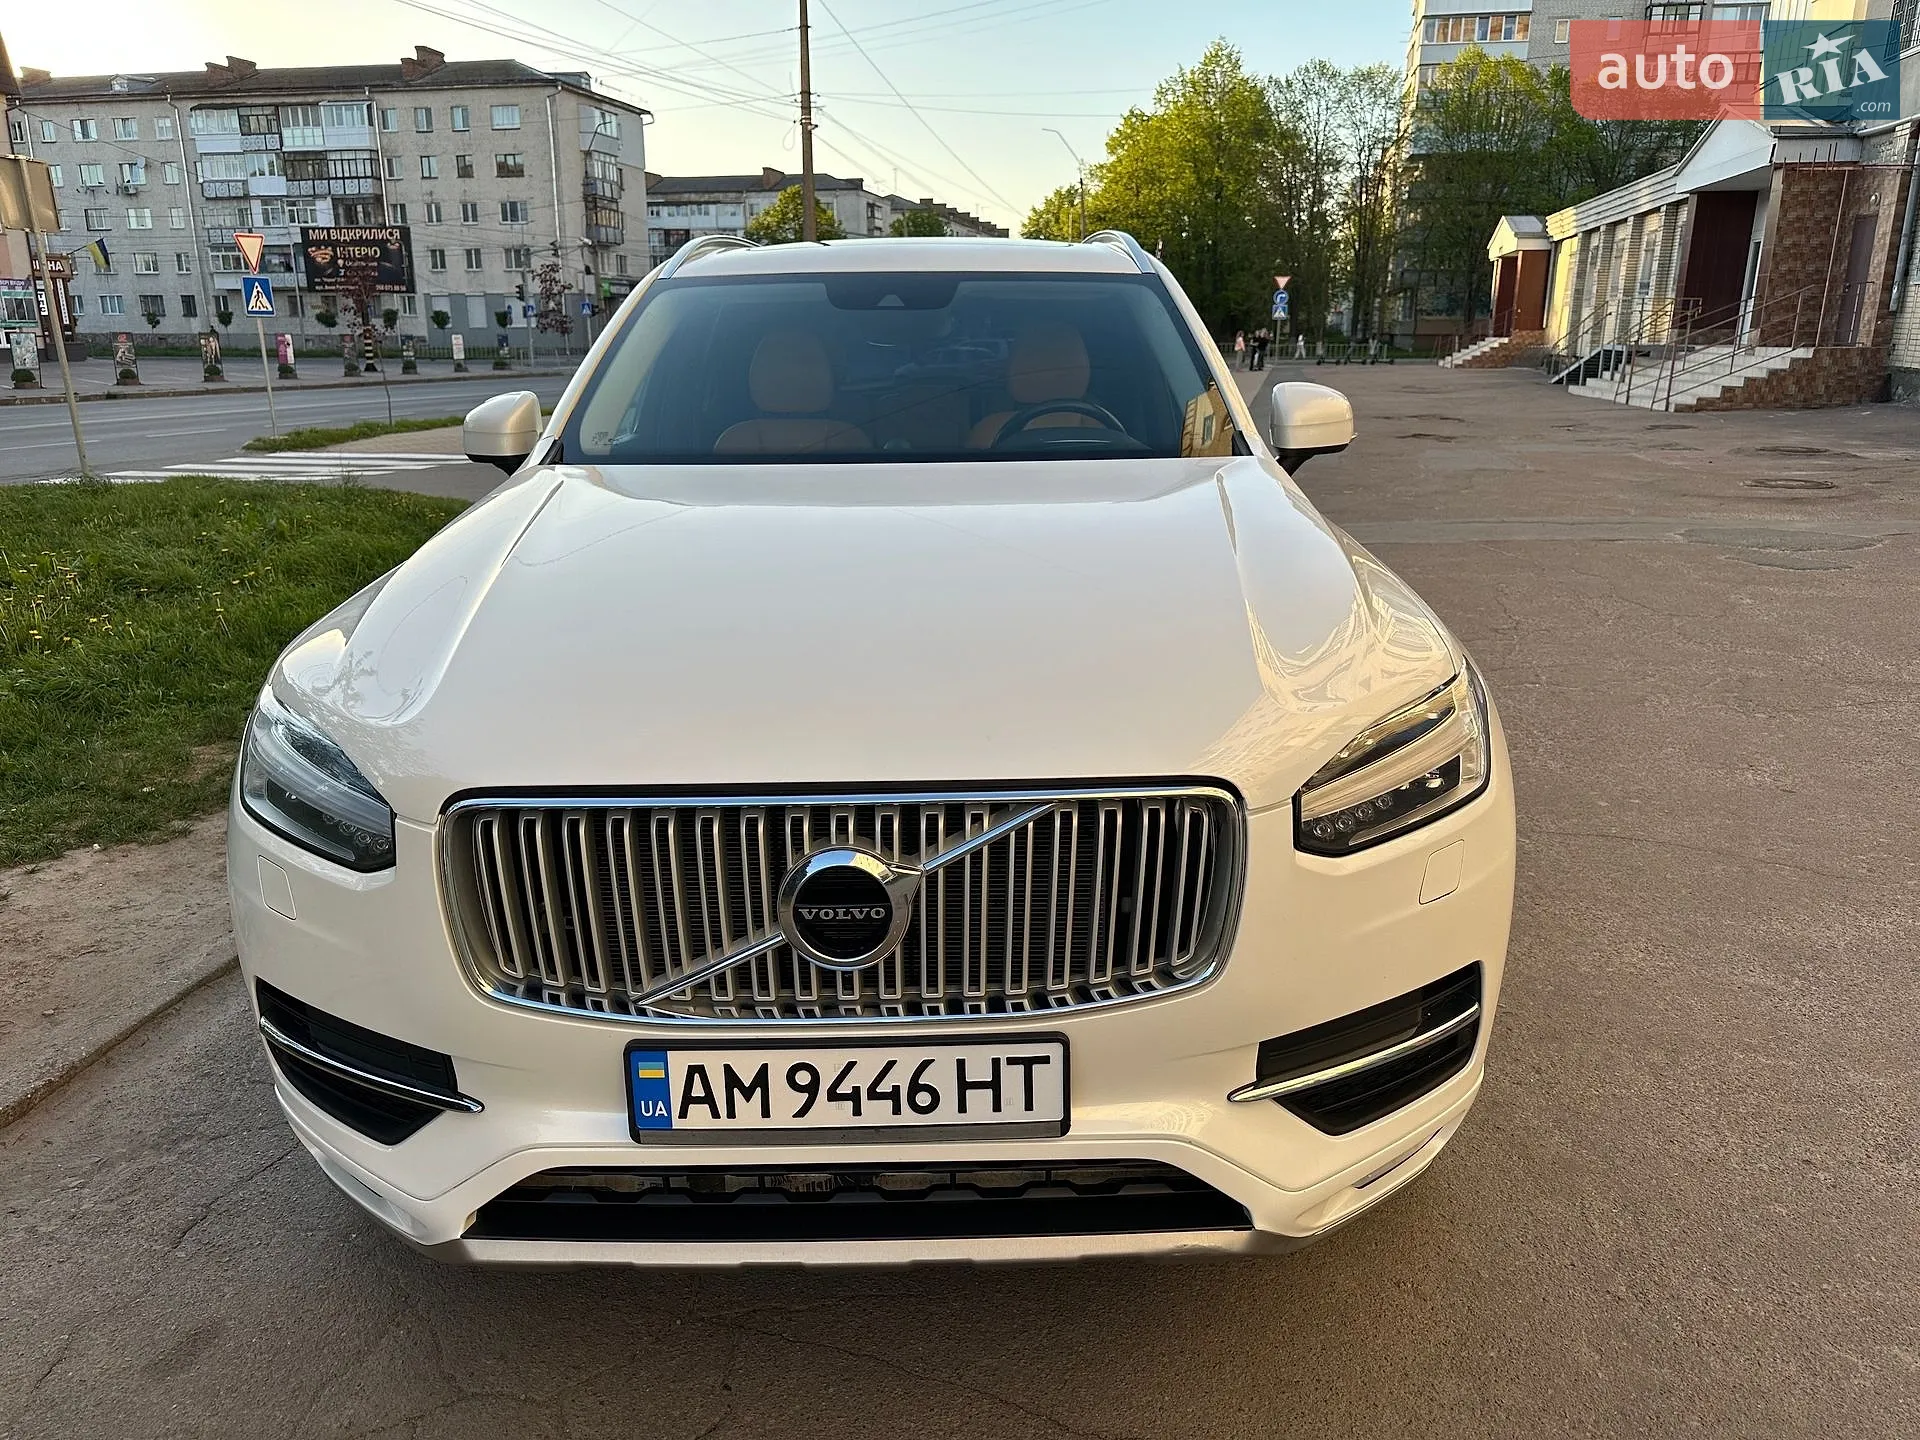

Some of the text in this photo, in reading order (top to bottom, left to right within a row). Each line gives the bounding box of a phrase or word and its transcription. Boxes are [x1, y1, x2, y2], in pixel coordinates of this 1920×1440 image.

[308, 228, 401, 242] МИ ВІДКРИЛИСЯ
[798, 907, 886, 920] VOLVO
[677, 1055, 1051, 1120] AM 9446 HT
[640, 1101, 669, 1117] UA
